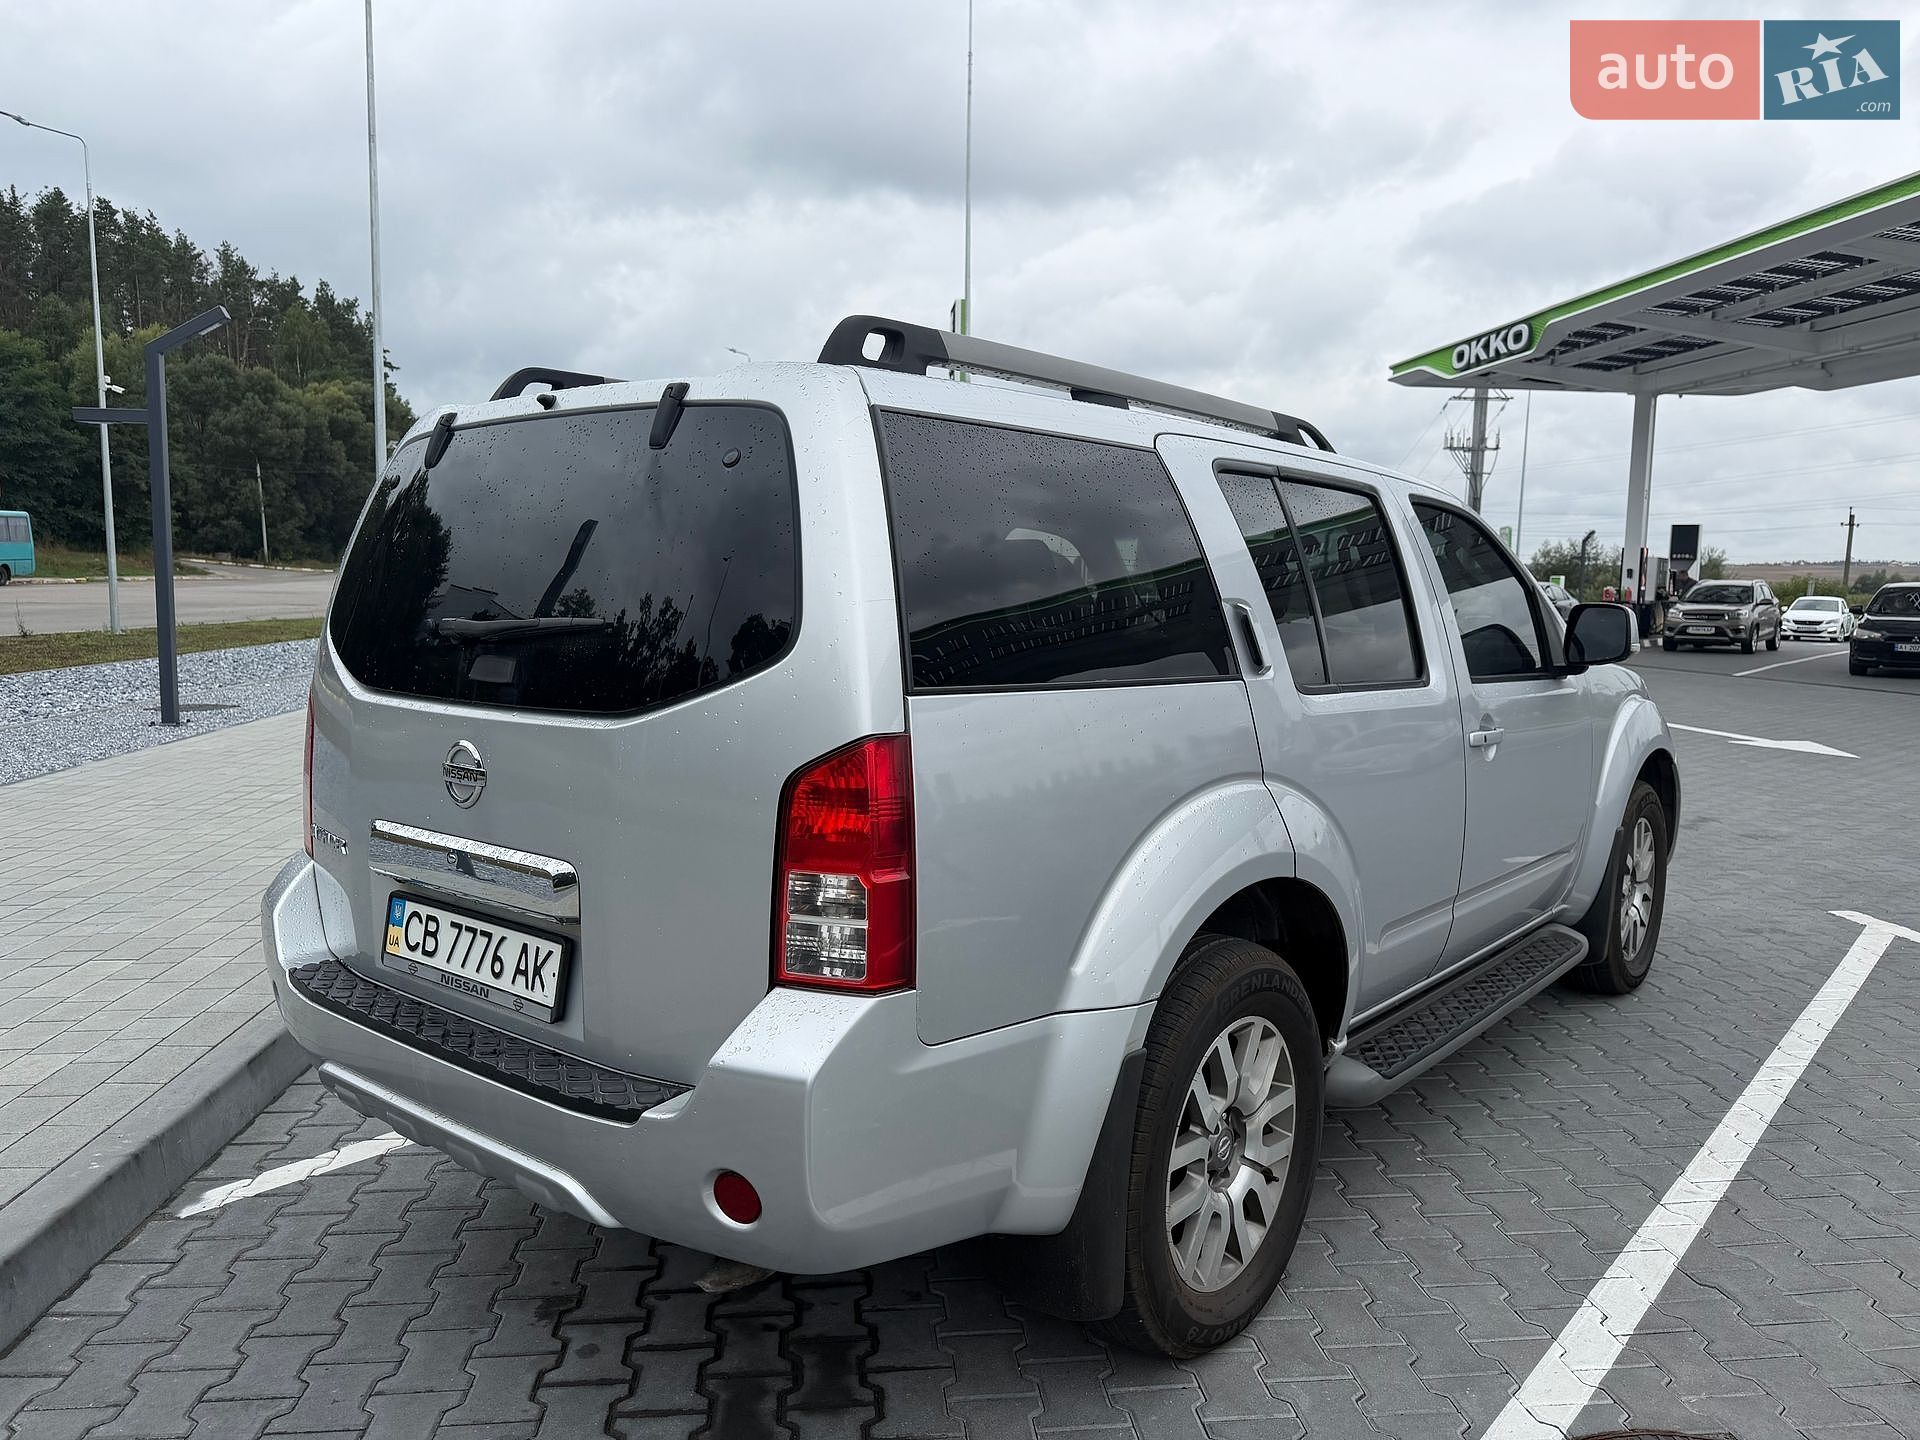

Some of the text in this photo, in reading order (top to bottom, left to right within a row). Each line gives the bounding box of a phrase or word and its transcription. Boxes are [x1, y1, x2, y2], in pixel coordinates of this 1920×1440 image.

[1451, 323, 1529, 370] OKKO
[442, 766, 479, 782] NISSAN
[388, 934, 400, 948] UA
[404, 910, 554, 993] CB 7776 AK
[440, 973, 490, 998] NISSAN
